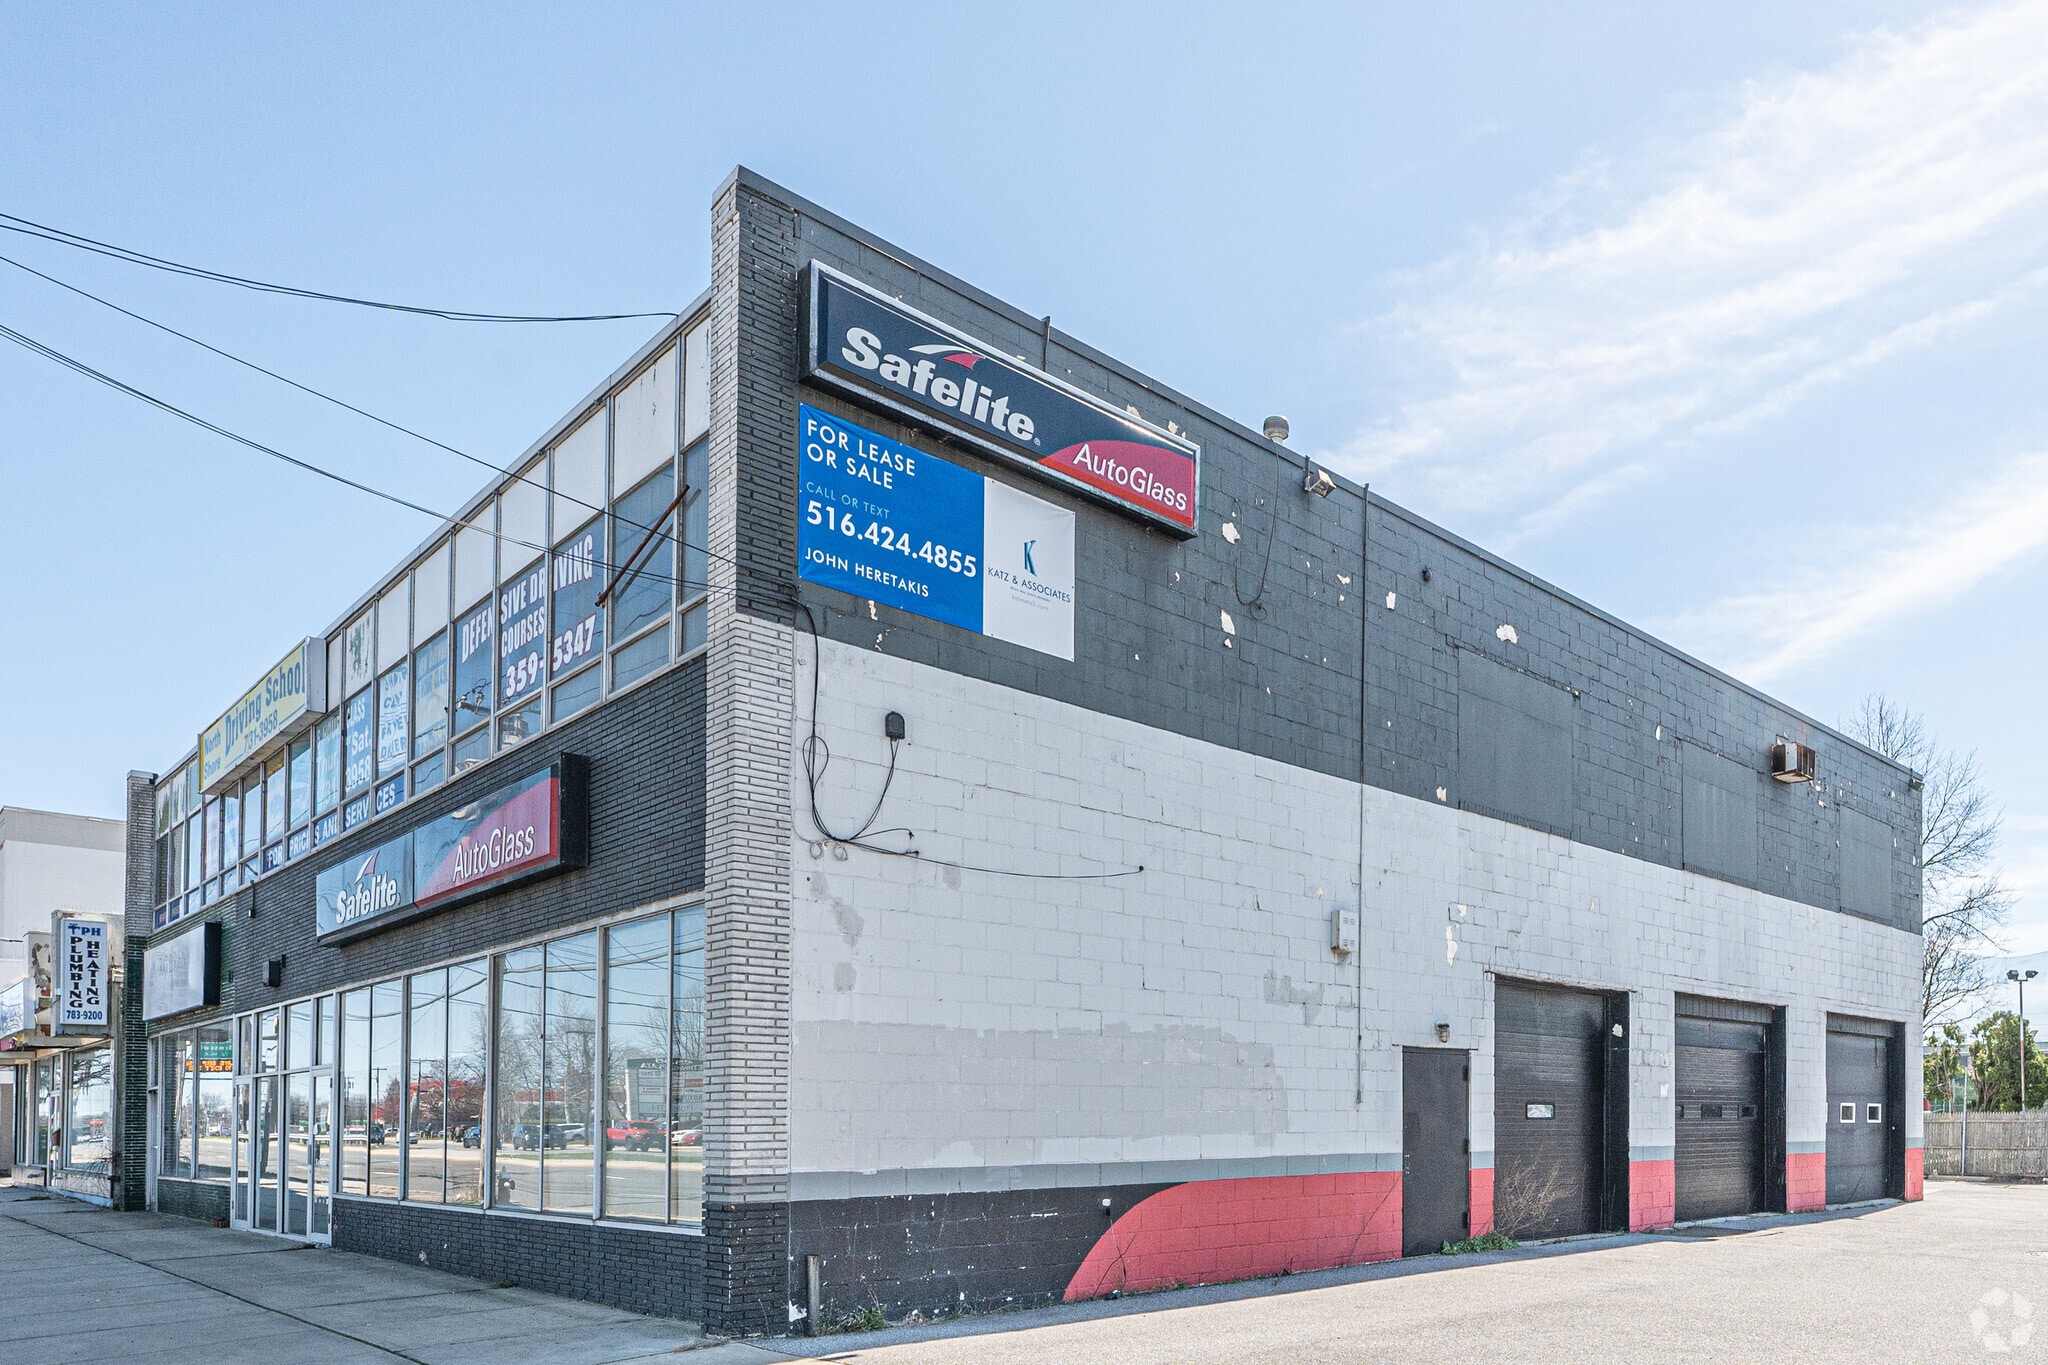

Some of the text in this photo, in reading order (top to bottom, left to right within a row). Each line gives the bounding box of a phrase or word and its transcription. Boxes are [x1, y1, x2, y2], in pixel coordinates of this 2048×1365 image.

[841, 326, 1036, 442] Safelite
[806, 443, 893, 490] OR SALE
[807, 419, 915, 476] FOR LEASE
[806, 481, 890, 520] CALL OR TEXT
[1073, 443, 1188, 512] AutoGlass
[806, 500, 977, 578] 516.424.4855
[805, 547, 929, 598] JOHN HERETAKIS
[988, 566, 1009, 582] KATZ
[1012, 575, 1018, 585] &
[1021, 579, 1071, 603] ASSOCIATES
[501, 605, 545, 659] COURSES
[224, 645, 305, 757] Driving School
[204, 728, 221, 757] North
[243, 709, 278, 753] 731-3958
[204, 757, 221, 780] Shore
[452, 825, 535, 884] AutoGlass
[336, 871, 398, 924] Safelite
[69, 936, 83, 1008] PLUMBING
[86, 941, 101, 1005] HEATING
[66, 1010, 103, 1020] 783-9200
